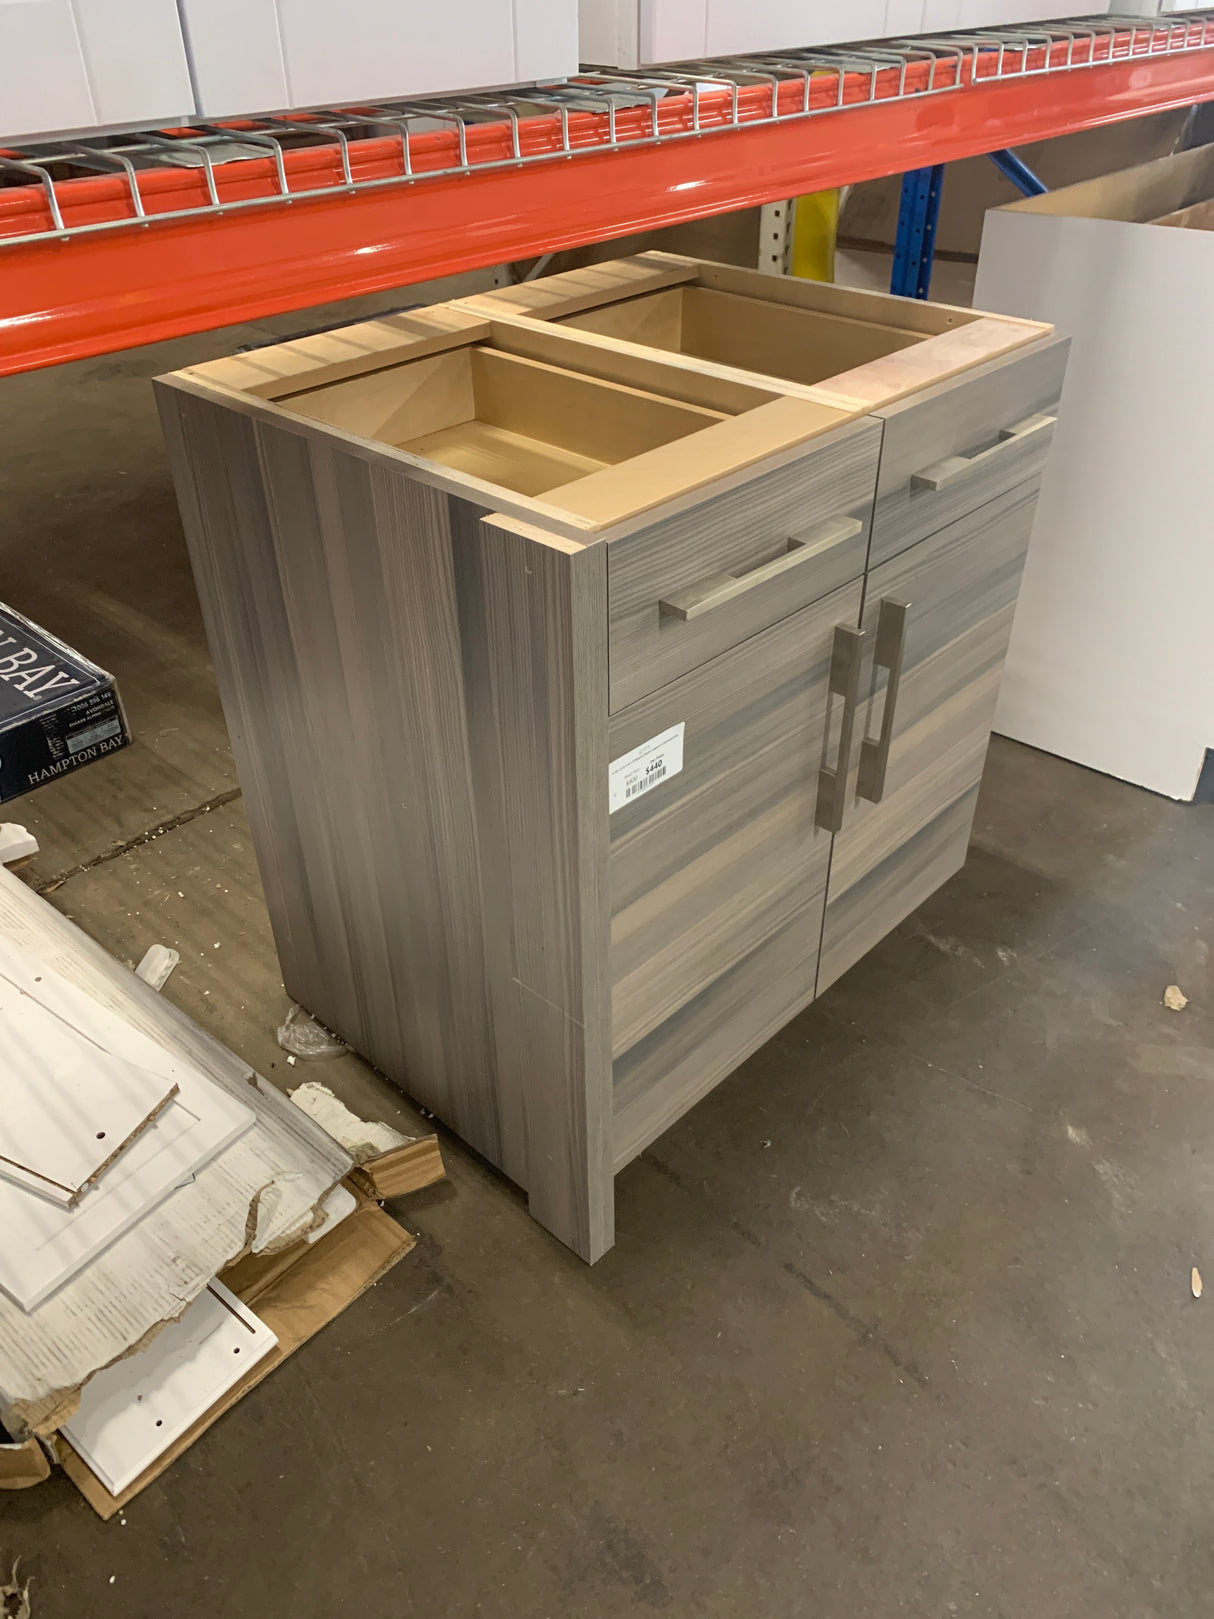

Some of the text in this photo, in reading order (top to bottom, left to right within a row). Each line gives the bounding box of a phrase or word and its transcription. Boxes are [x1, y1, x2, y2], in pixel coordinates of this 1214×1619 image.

[0, 647, 81, 699] BAY
[28, 746, 97, 784] HAMPTON
[99, 734, 123, 752] BAY
[645, 759, 663, 775] $440
